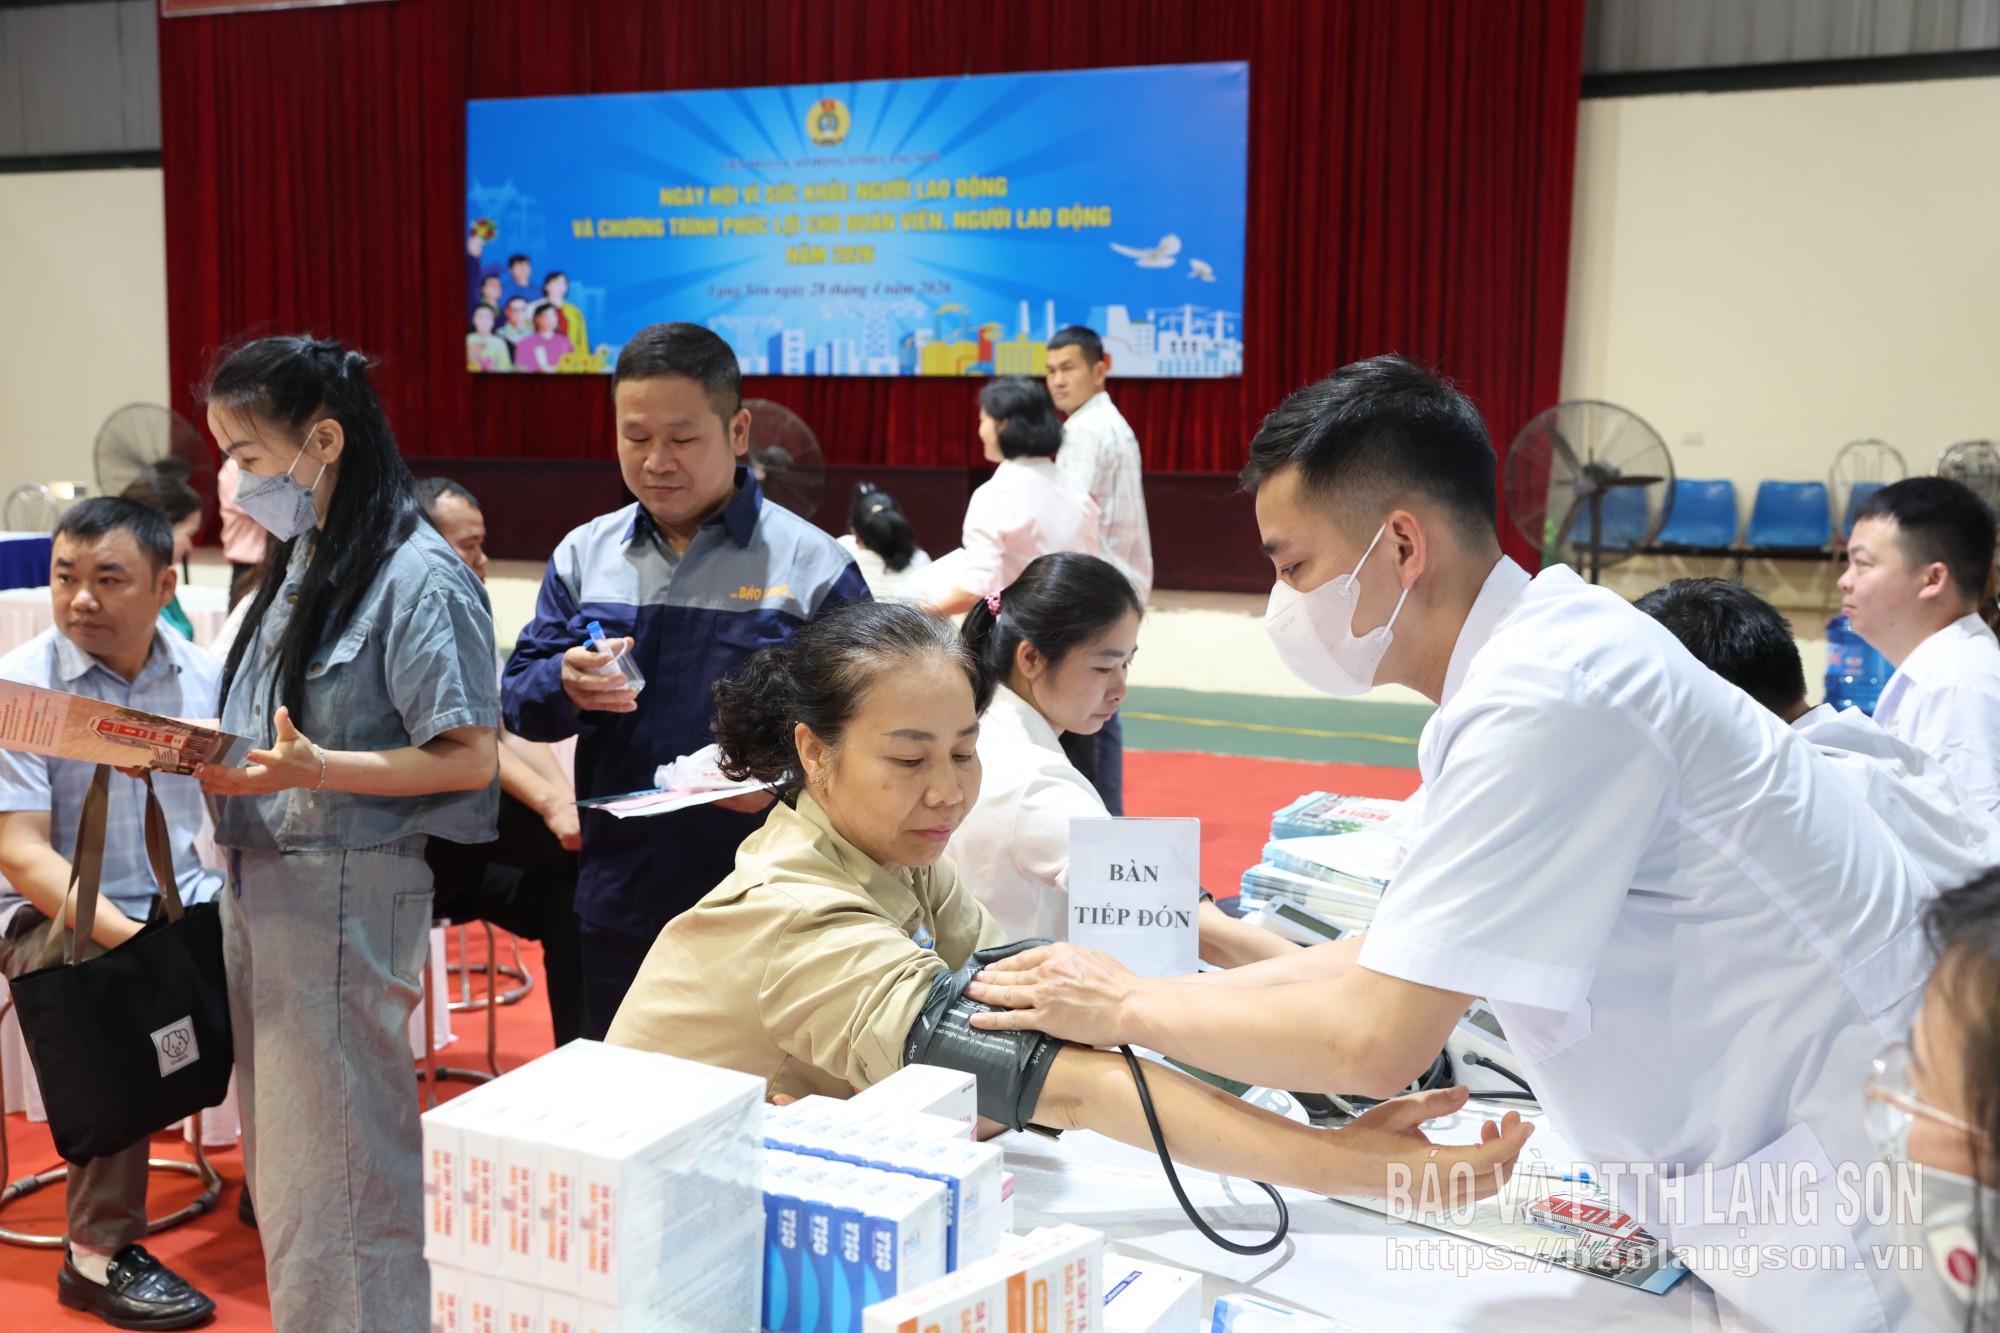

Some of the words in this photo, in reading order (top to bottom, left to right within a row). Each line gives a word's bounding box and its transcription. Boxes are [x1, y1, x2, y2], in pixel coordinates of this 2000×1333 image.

[916, 178, 950, 199] LAO
[955, 173, 1008, 201] ĐỘNG
[1016, 207, 1052, 229] LAO
[1057, 202, 1112, 232] ĐỘNG
[1109, 859, 1159, 883] BÀN
[1074, 902, 1131, 926] TIẾP
[1137, 904, 1192, 929] ĐÓN
[1031, 1043, 1047, 1066] Mark
[781, 1209, 797, 1249] OSLA
[812, 1215, 829, 1257] OSLA
[844, 1222, 861, 1264] OSLA
[875, 1230, 892, 1272] OSLA
